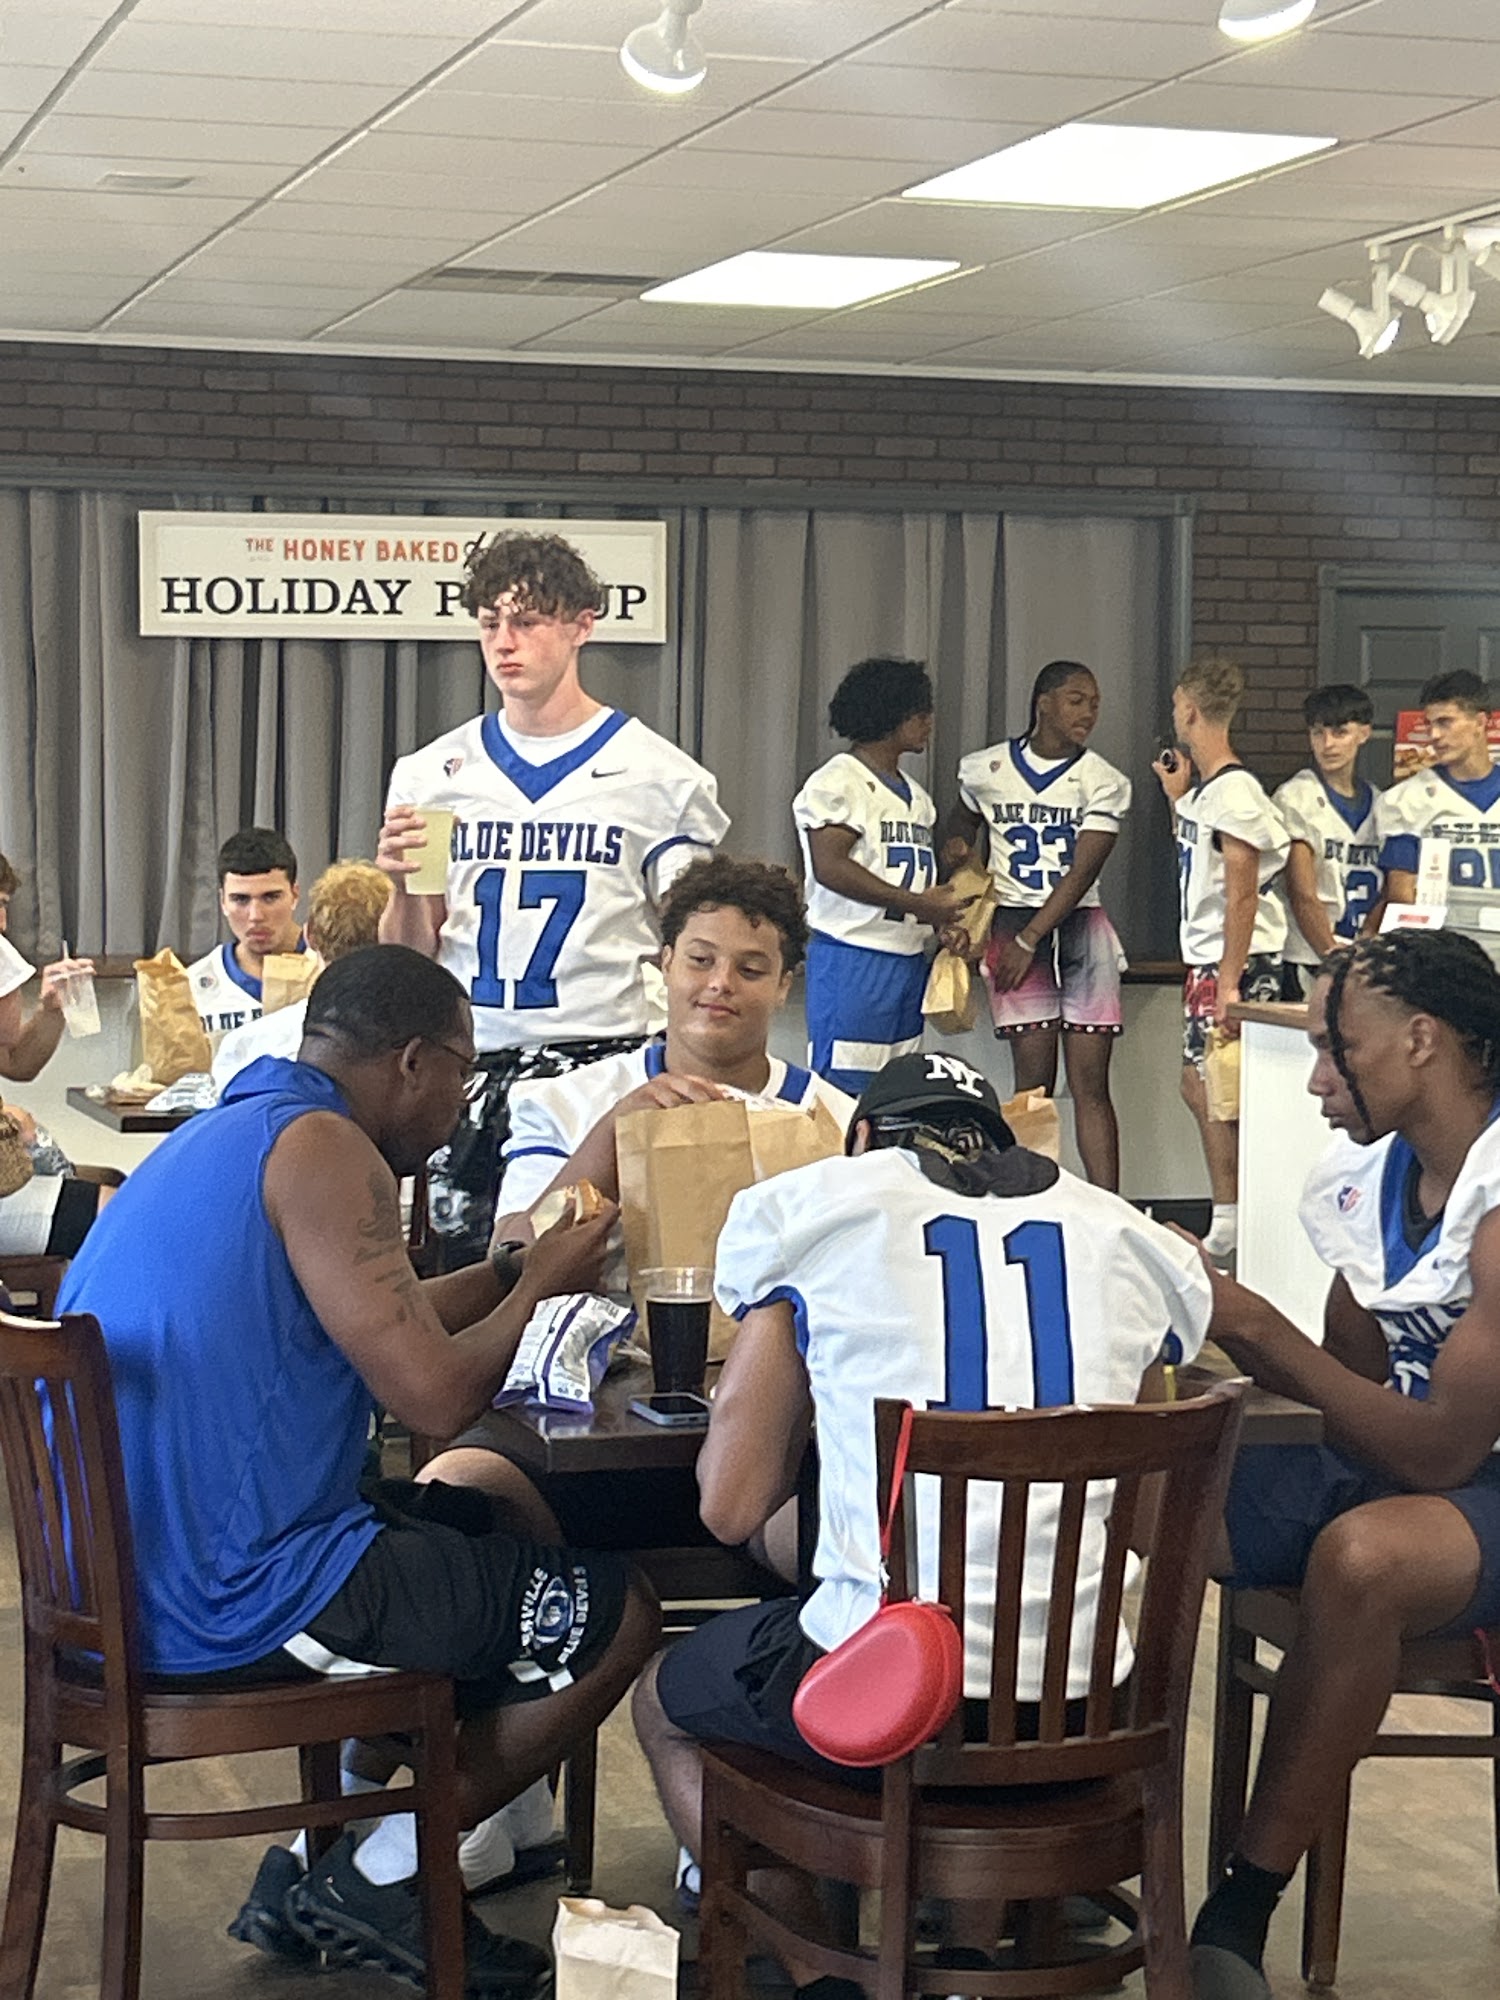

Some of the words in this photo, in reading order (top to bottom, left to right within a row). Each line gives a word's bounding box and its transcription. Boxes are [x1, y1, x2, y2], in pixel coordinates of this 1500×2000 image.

[245, 538, 274, 552] THE
[283, 539, 365, 562] HONEY
[376, 540, 459, 563] BAKED
[160, 576, 412, 616] HOLIDAY
[519, 822, 625, 866] DEVILS
[1003, 824, 1076, 891] 23
[470, 867, 588, 1010] 17
[924, 1053, 985, 1099] NY
[922, 1213, 1075, 1412] 11
